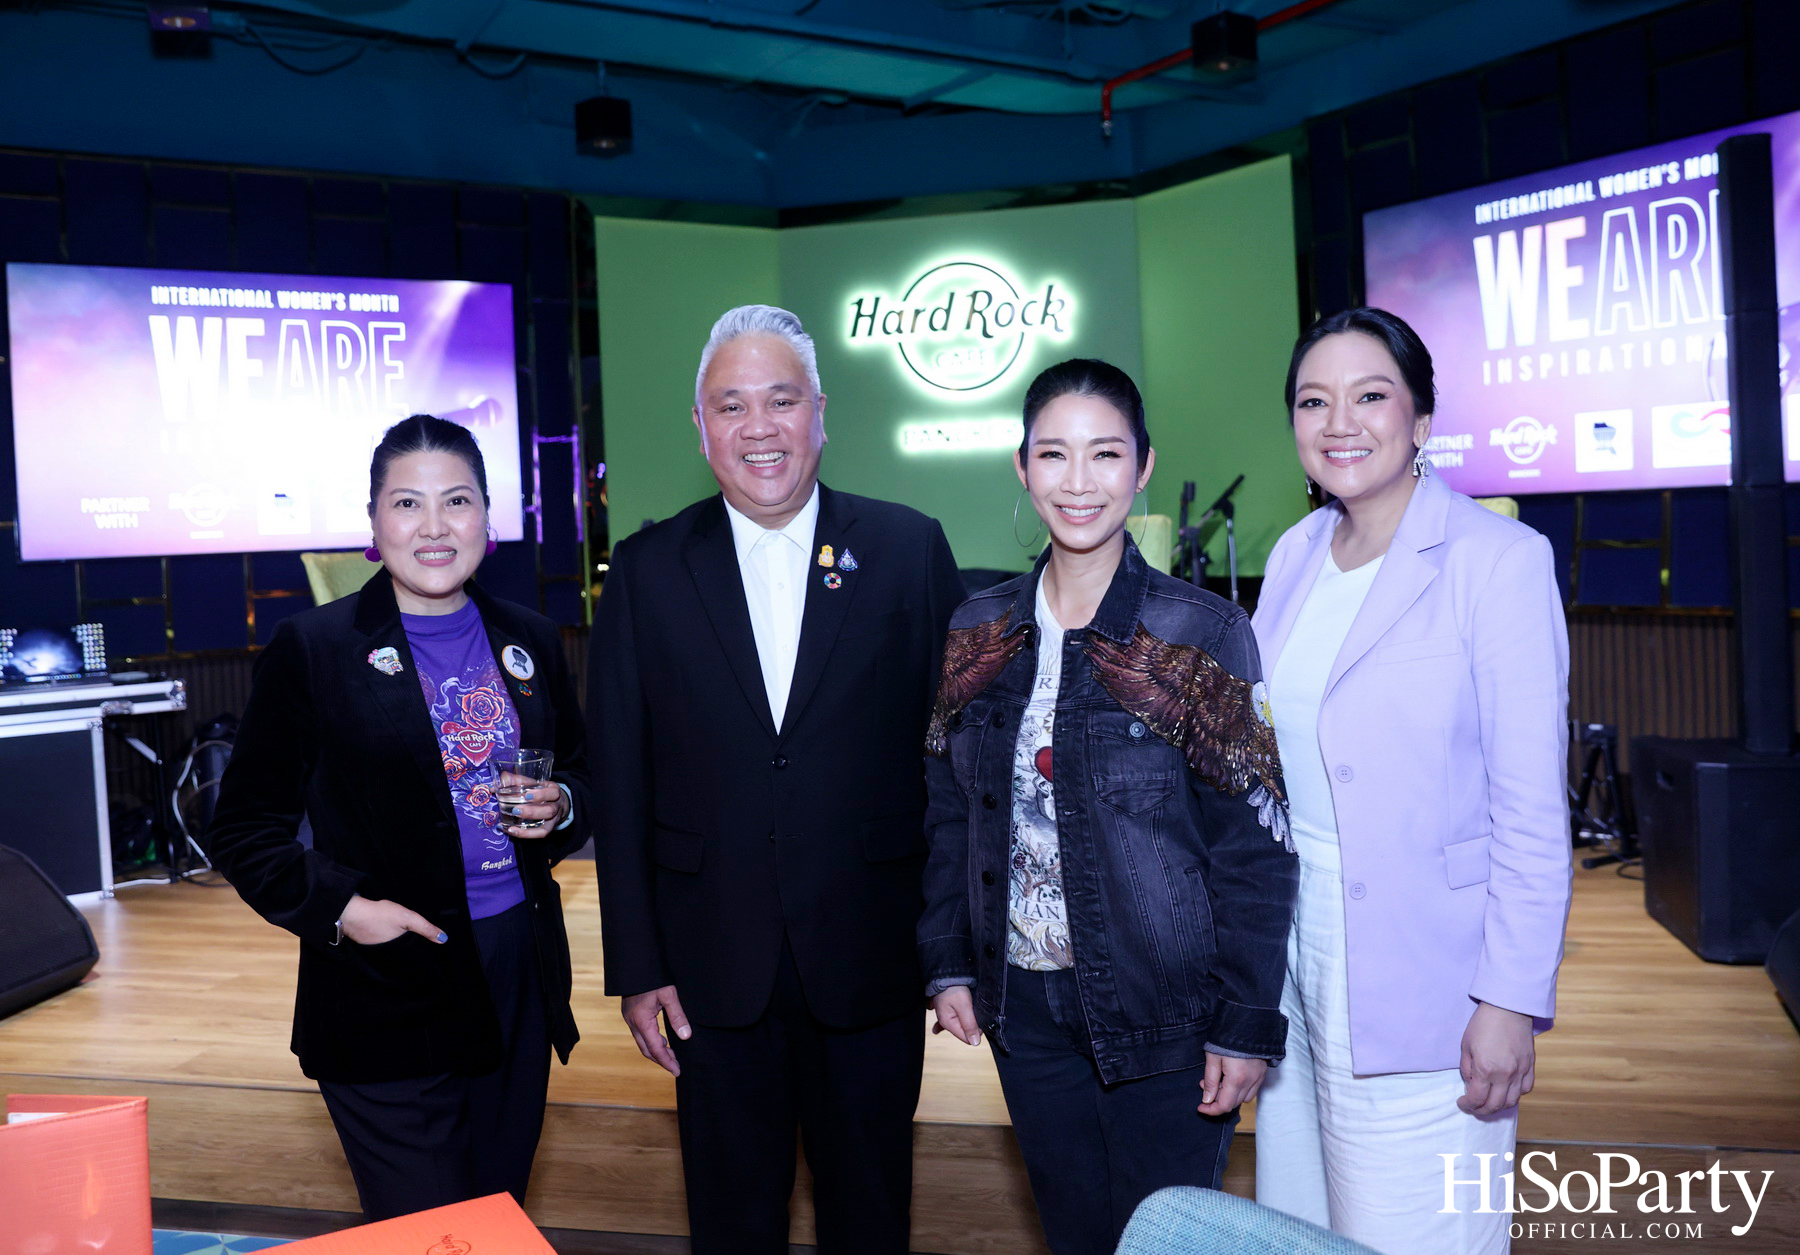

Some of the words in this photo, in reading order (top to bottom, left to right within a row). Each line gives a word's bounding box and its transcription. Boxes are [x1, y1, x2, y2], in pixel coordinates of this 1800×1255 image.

[1475, 179, 1596, 225] INTERNATIONAL
[1599, 161, 1680, 199] WOMEN'S
[1473, 216, 1590, 351] WE
[151, 286, 274, 308] INTERNATIONAL
[277, 290, 346, 311] WOMEN'S
[349, 293, 399, 313] MONTH
[850, 290, 955, 338] Hard
[965, 284, 1065, 339] Rock
[148, 315, 266, 422] WE
[273, 318, 410, 418] ARE
[80, 497, 151, 514] PARTNER
[94, 512, 139, 529] WITH
[447, 734, 470, 742] Hard
[470, 731, 496, 743] Rock
[481, 854, 513, 871] Bangkok
[1012, 891, 1061, 920] TIAN
